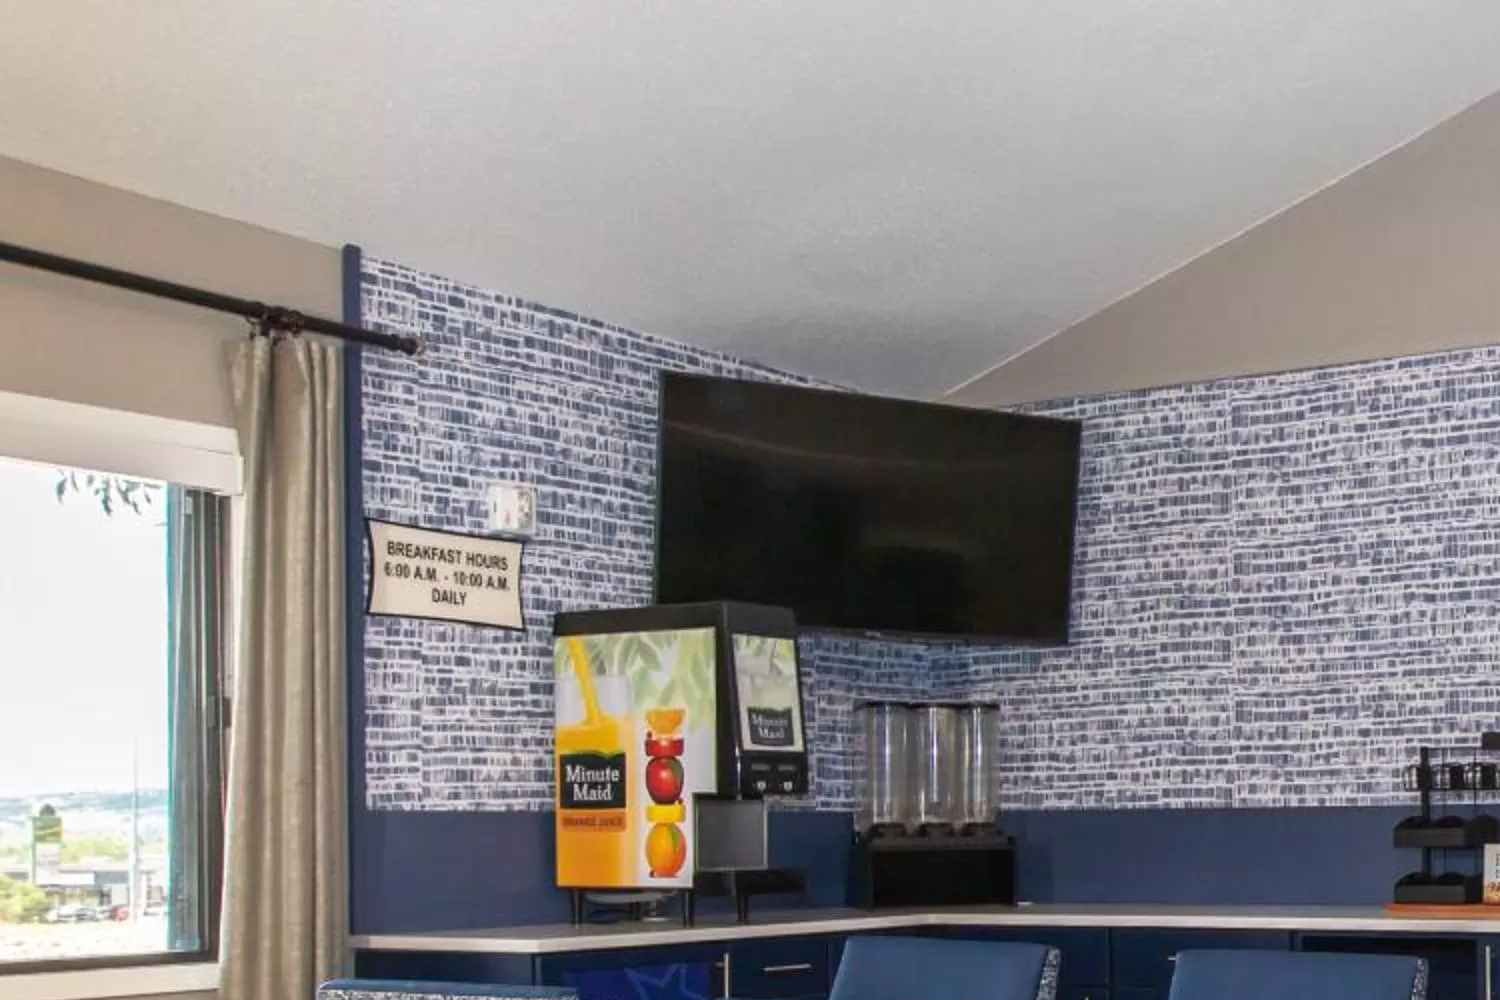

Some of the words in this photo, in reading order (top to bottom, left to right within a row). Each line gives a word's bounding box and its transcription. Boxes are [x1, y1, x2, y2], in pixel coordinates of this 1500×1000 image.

[387, 540, 463, 565] BREAKFAST
[466, 551, 509, 571] HOURS
[384, 561, 411, 579] 6:00
[414, 565, 438, 582] A.M.
[453, 571, 483, 587] 10:00
[486, 575, 511, 591] A.M.
[431, 587, 467, 607] DAILY
[565, 764, 620, 783] Minute
[573, 783, 613, 801] Maid
